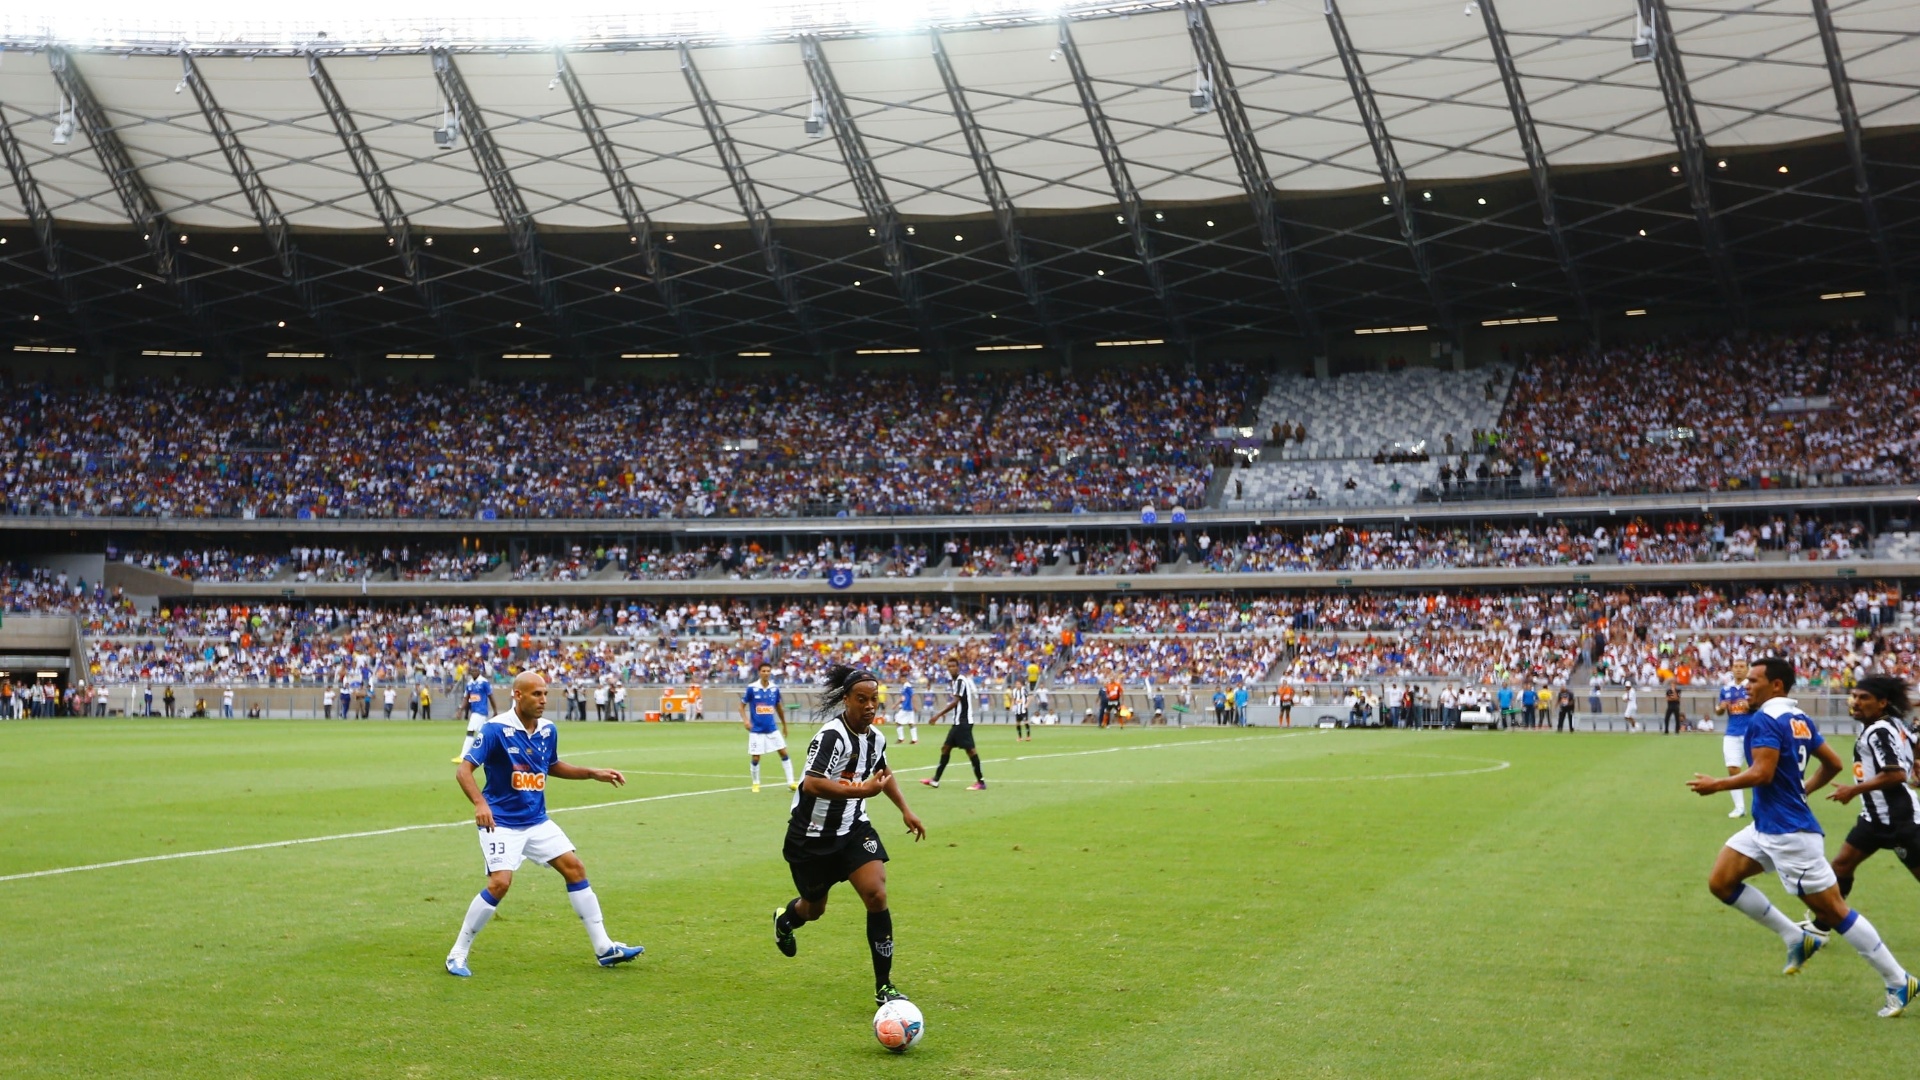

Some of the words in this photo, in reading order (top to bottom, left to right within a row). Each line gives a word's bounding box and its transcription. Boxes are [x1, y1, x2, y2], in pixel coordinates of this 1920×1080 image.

[826, 747, 840, 776] MRV
[512, 772, 546, 791] BMG
[489, 842, 506, 855] 33
